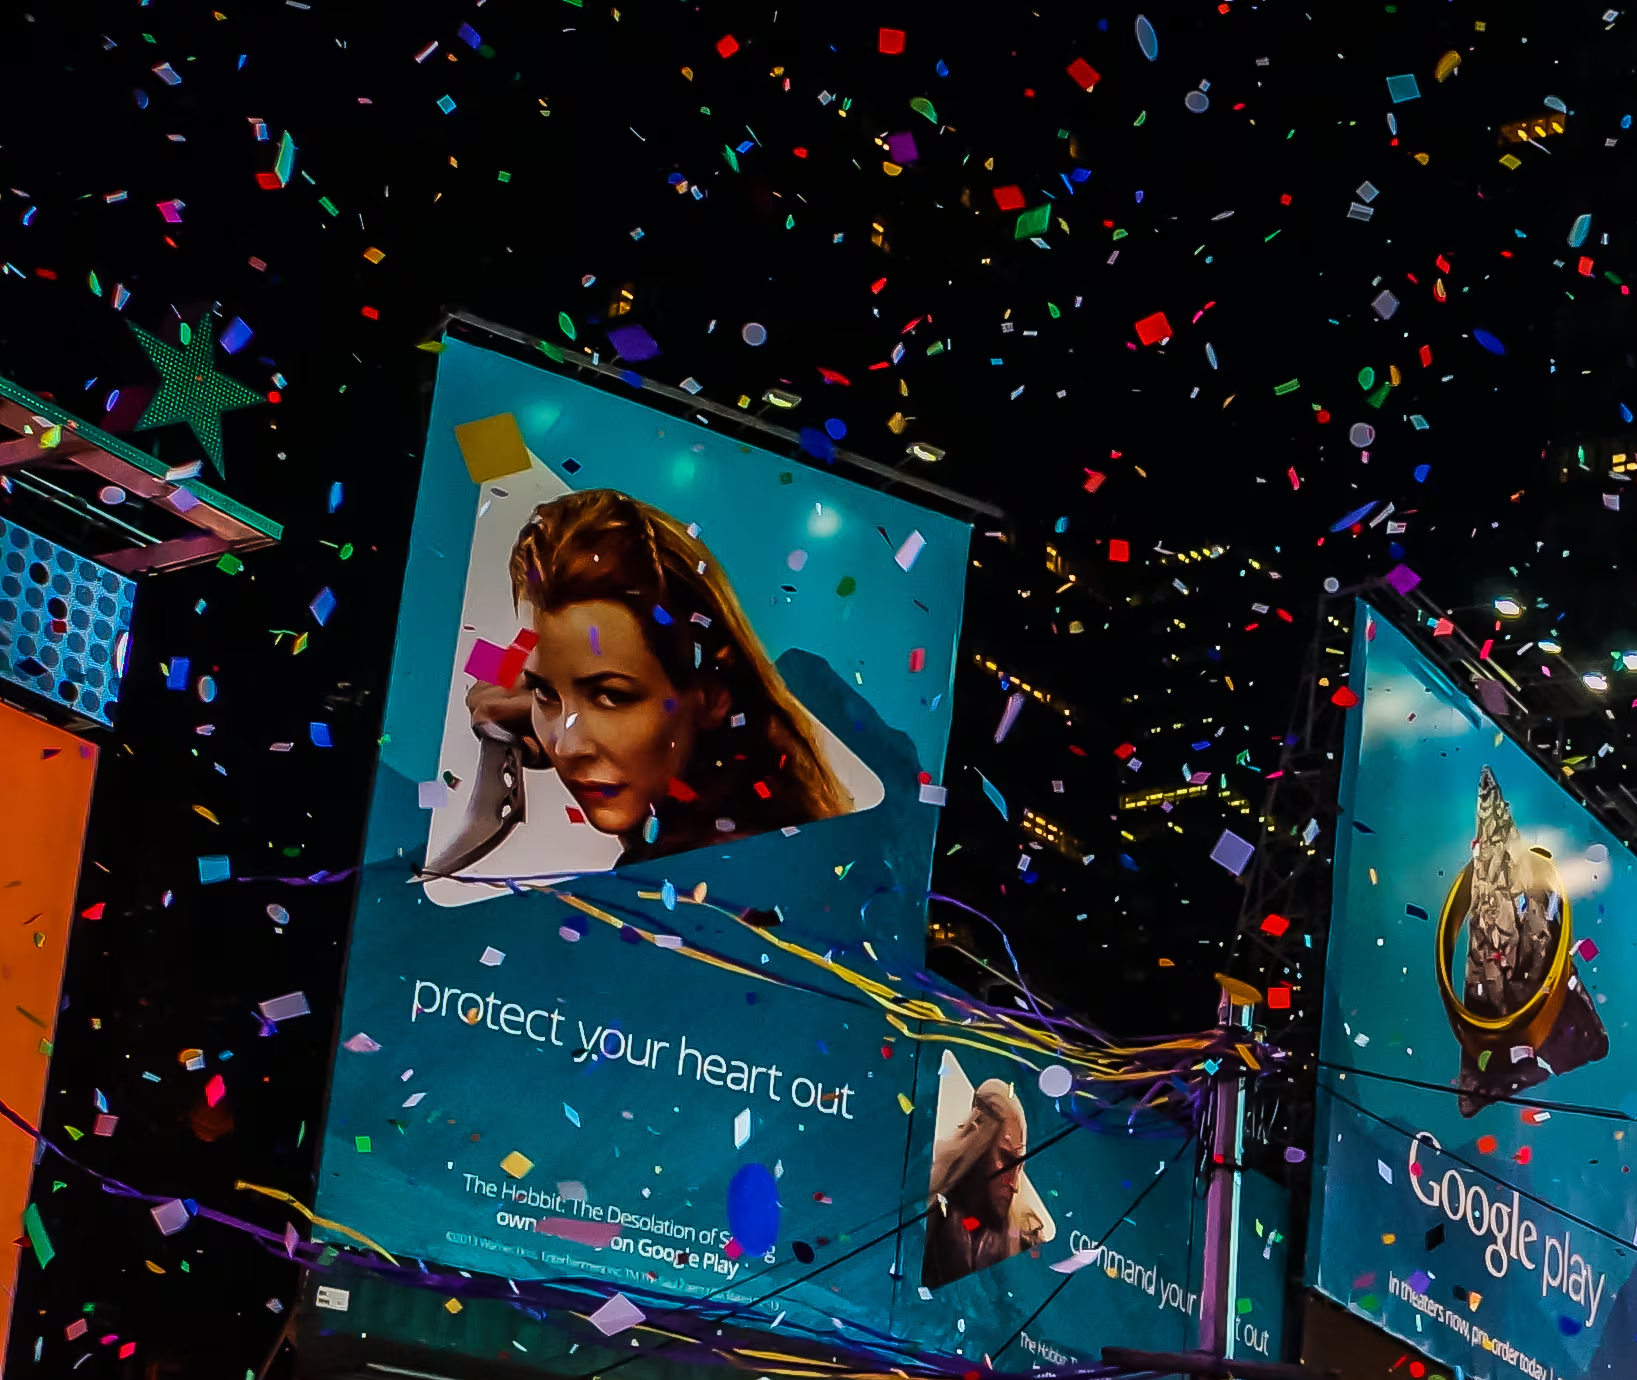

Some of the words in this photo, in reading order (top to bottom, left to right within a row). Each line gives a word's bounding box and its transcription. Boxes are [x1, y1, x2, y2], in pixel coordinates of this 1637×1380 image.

[412, 978, 562, 1046] protect
[575, 1015, 669, 1072] your
[678, 1034, 781, 1101] heart
[792, 1076, 855, 1120] out
[463, 1173, 497, 1198] The
[502, 1183, 567, 1213] Hobbit:
[571, 1199, 603, 1220] The
[607, 1206, 695, 1241] Desolation
[699, 1226, 719, 1245] of
[496, 1211, 536, 1230] own
[610, 1236, 634, 1252] on
[1409, 1131, 1537, 1278] Google
[1542, 1231, 1606, 1328] play
[1158, 1278, 1196, 1316] your
